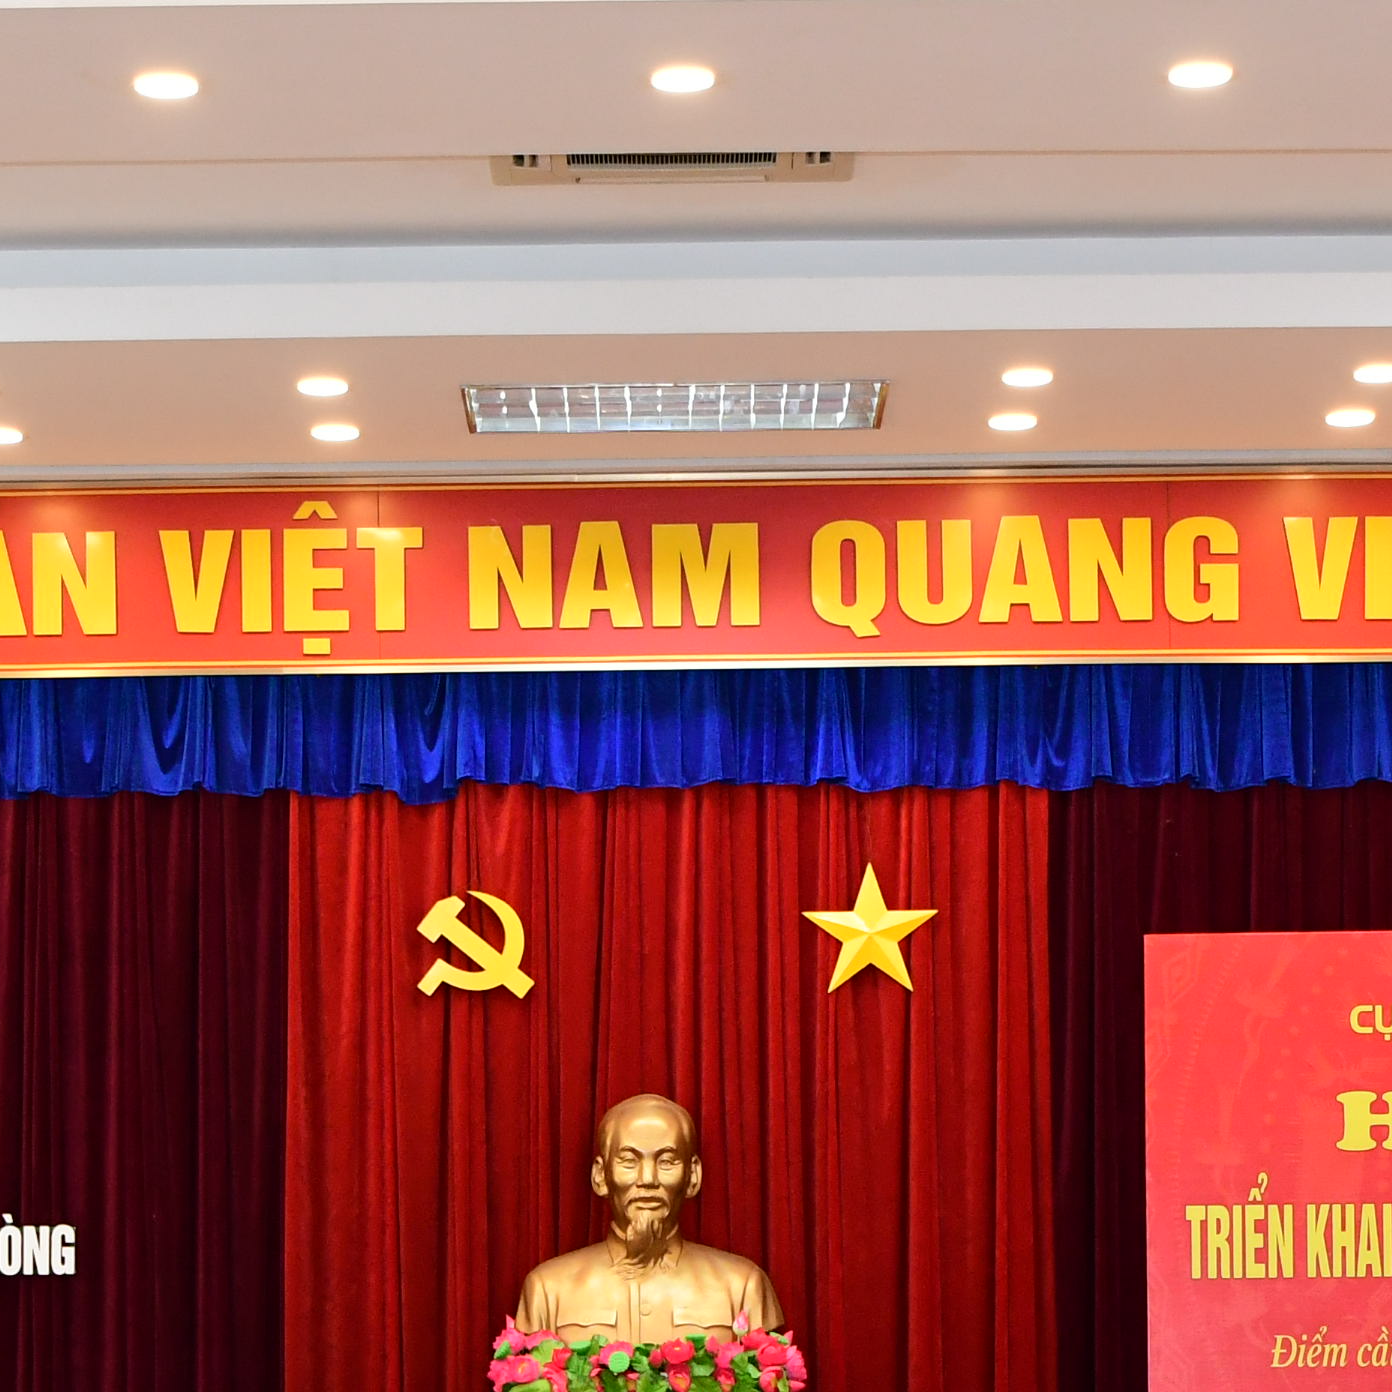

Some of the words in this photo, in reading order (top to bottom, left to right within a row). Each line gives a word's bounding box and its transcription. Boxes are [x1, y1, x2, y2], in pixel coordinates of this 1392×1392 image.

[160, 501, 423, 655] VIỆT
[468, 521, 760, 630] NAM
[811, 516, 1240, 638] QUANG
[1186, 1172, 1293, 1279] TRIỂN
[1307, 1203, 1392, 1278] KHAI
[1270, 1326, 1347, 1368] Điểm
